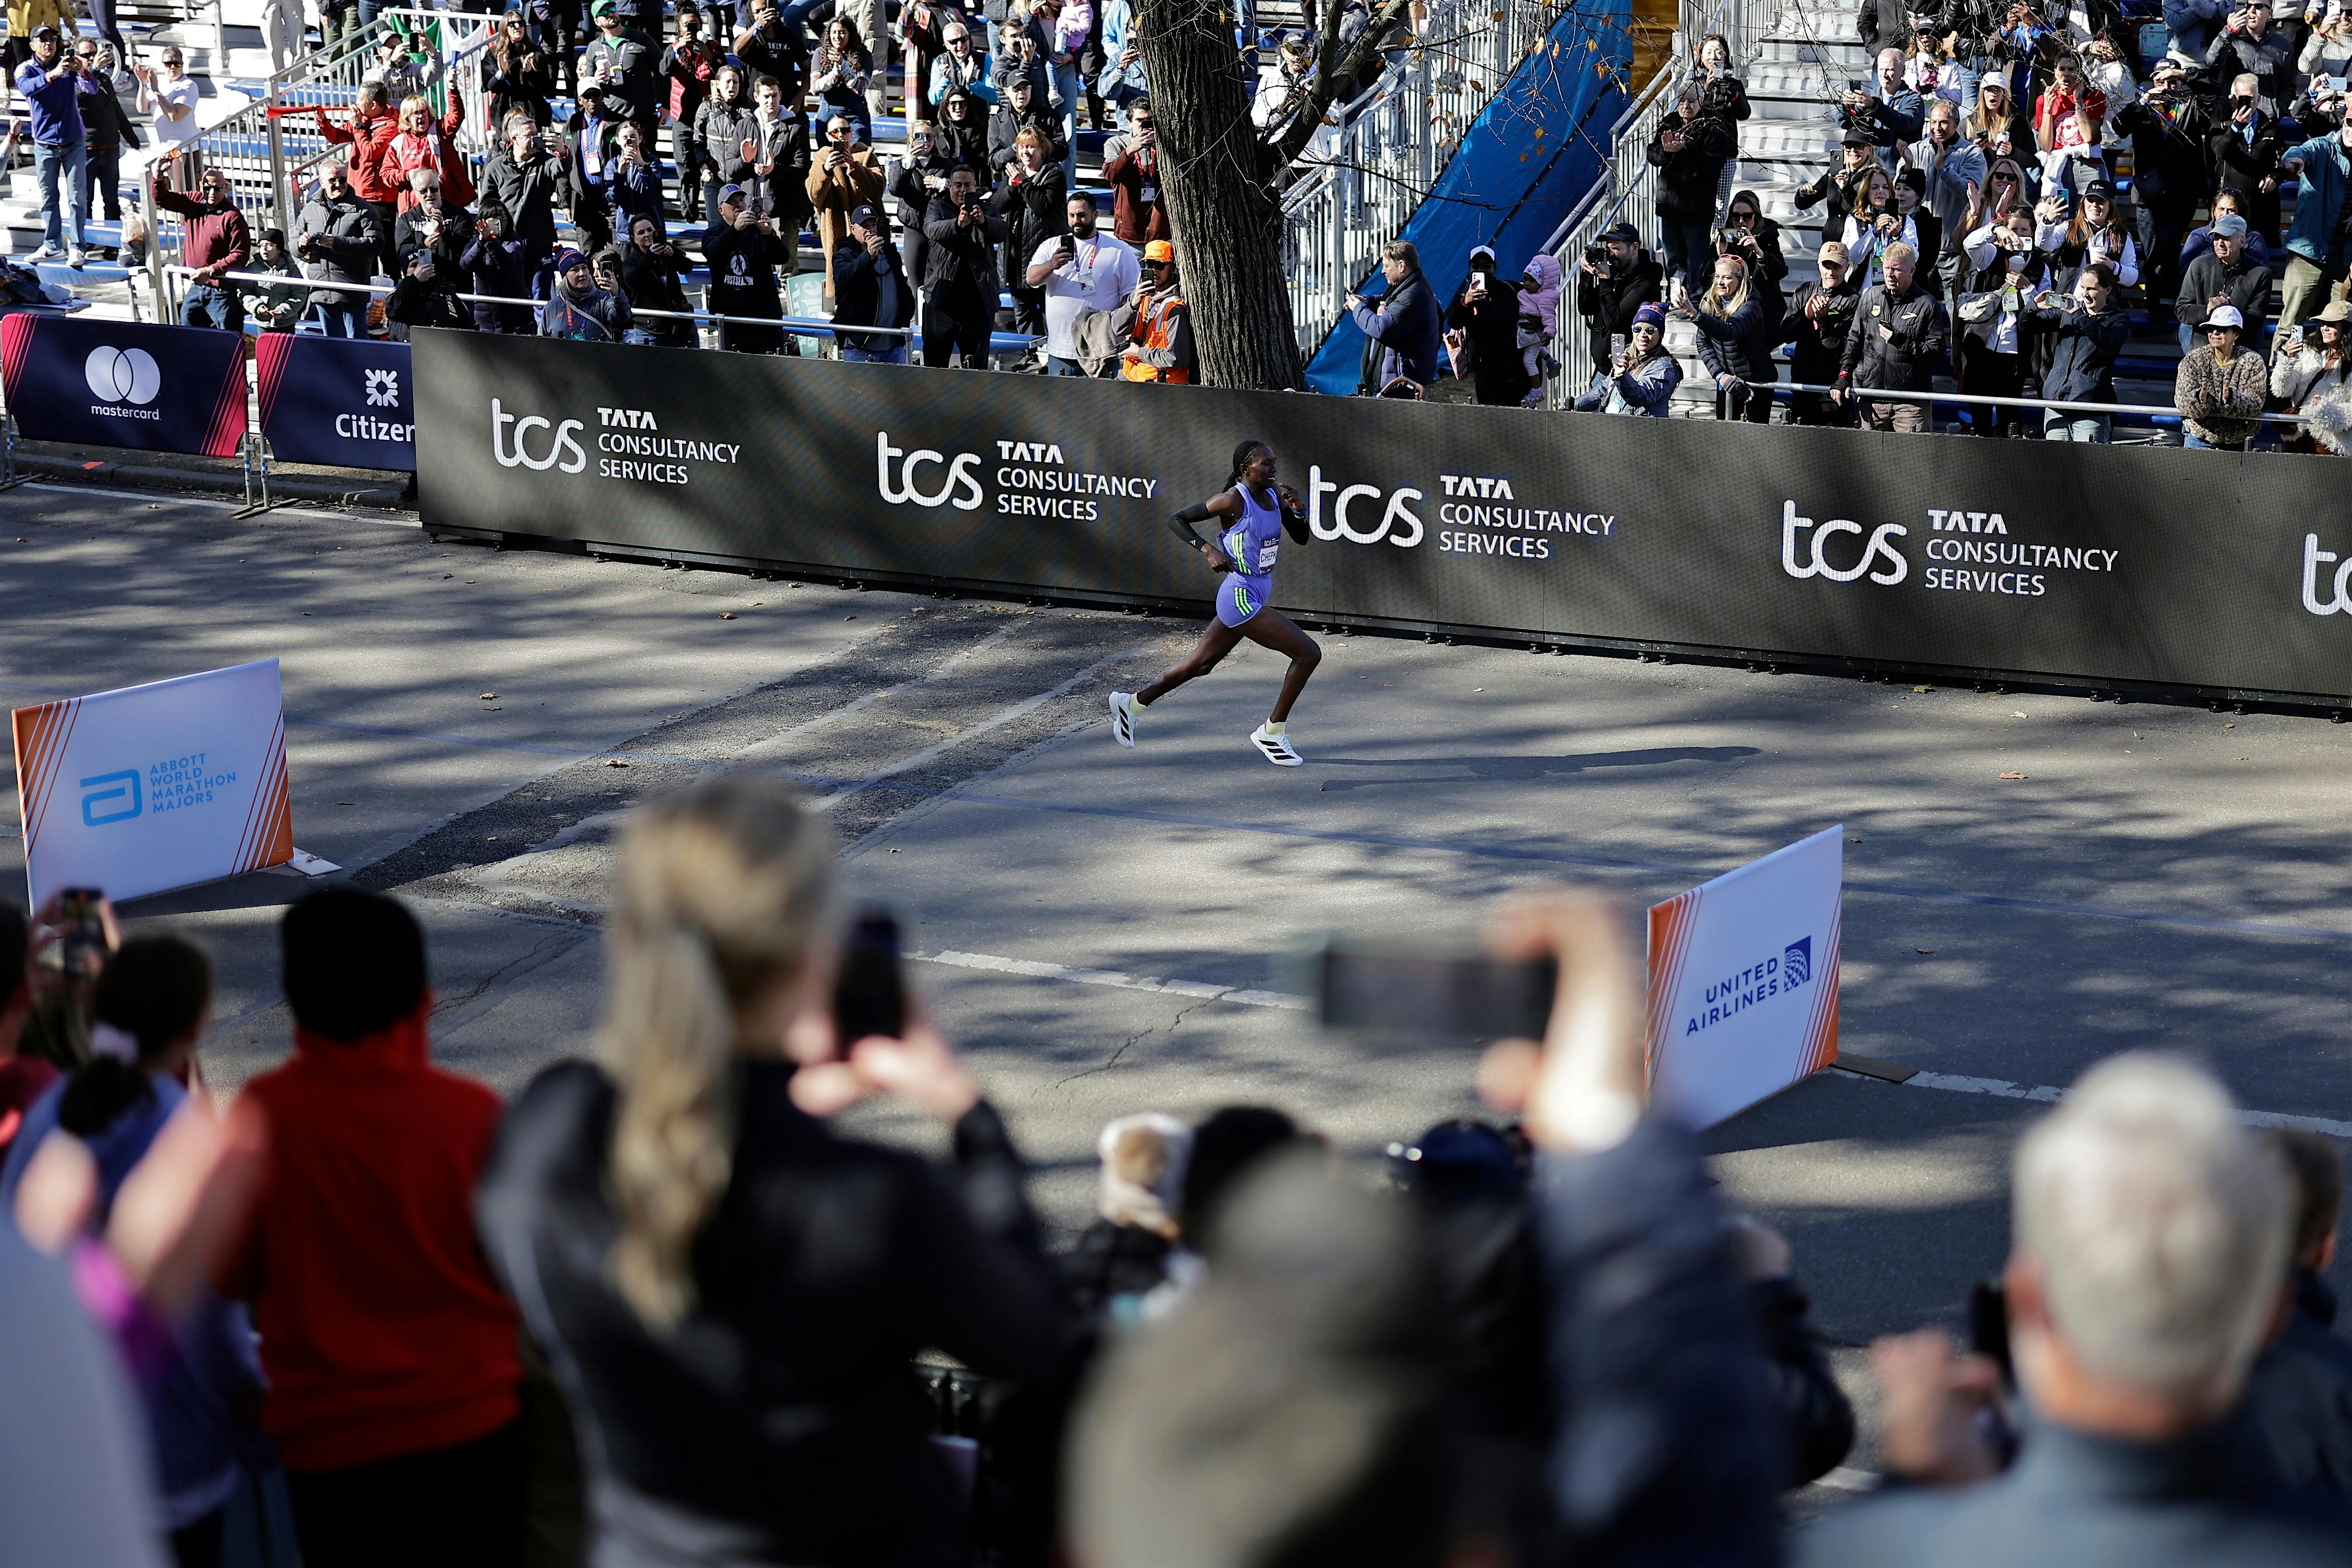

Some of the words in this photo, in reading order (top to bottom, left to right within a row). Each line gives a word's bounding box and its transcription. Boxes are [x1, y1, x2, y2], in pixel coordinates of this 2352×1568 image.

[91, 406, 160, 421] mastercard
[597, 407, 658, 430] TATA
[491, 397, 587, 474] tcs
[598, 433, 740, 463] CONSULTANCY
[997, 440, 1064, 464] TATA
[599, 458, 689, 484] SERVICES
[878, 431, 983, 510] tcs
[997, 468, 1157, 499] CONSULTANCY
[1440, 475, 1514, 500] TATA
[997, 494, 1098, 521] SERVICES
[1309, 465, 1424, 547] tcs
[1440, 503, 1615, 536] CONSULTANCY
[1927, 509, 2008, 534] TATA
[1440, 531, 1549, 559] SERVICES
[1782, 499, 1907, 586] tcs
[1926, 538, 2118, 571] CONSULTANCY
[1925, 570, 2046, 596] SERVICES
[150, 753, 206, 775] ABBOTT
[150, 767, 202, 787] WORLD
[152, 772, 236, 801] MARATHON
[153, 790, 213, 813] MAJORS
[1706, 957, 1778, 1003] UNITED
[1686, 978, 1777, 1036] AIRLINES
